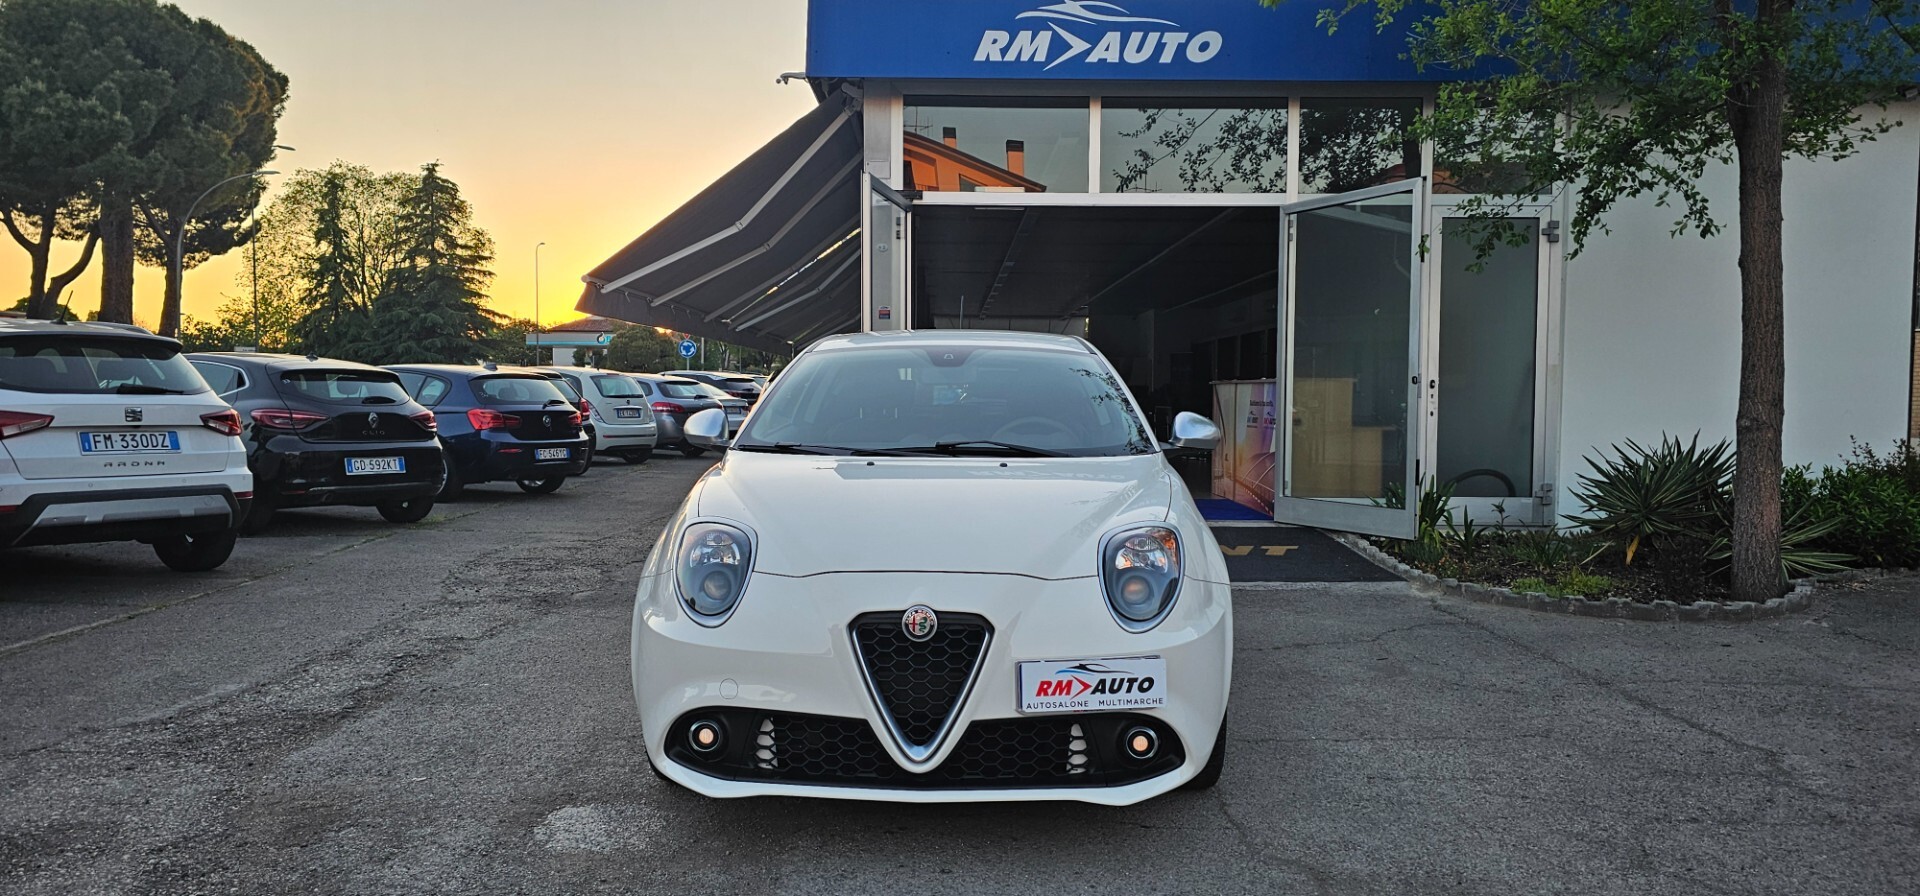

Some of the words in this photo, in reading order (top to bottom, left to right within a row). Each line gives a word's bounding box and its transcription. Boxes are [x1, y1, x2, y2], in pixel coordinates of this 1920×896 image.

[973, 30, 1052, 62] RM
[1085, 30, 1223, 64] AUTO
[92, 433, 114, 450] FM
[121, 432, 170, 449] 330DZ
[353, 459, 366, 471] GD
[369, 458, 398, 470] 592KT
[1035, 679, 1073, 697] RM
[1090, 676, 1155, 695] AUTO
[1026, 700, 1089, 710] AUTOSALONE
[1098, 697, 1164, 707] MULTIMARCHE
